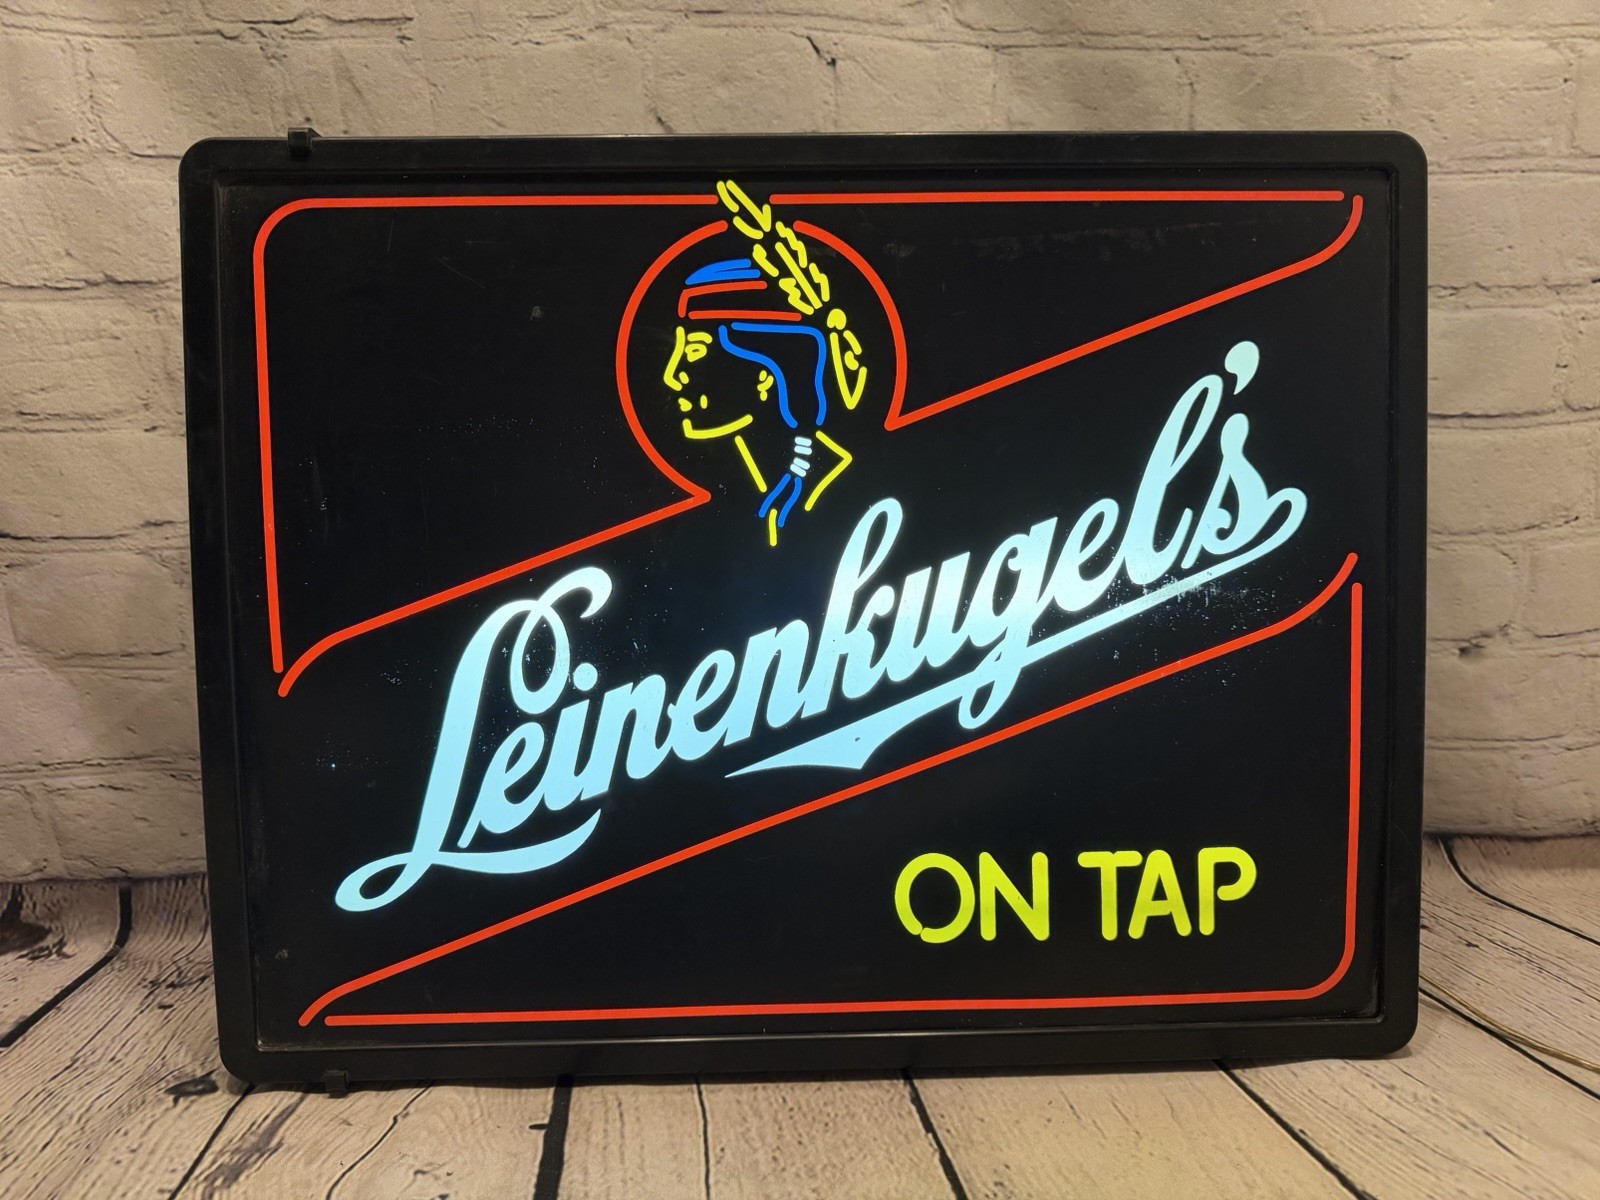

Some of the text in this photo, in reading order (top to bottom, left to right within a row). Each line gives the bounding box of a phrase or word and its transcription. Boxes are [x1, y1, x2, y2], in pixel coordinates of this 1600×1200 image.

[335, 341, 1307, 912] Leinenkugel's
[894, 847, 1257, 943] ON TAP
